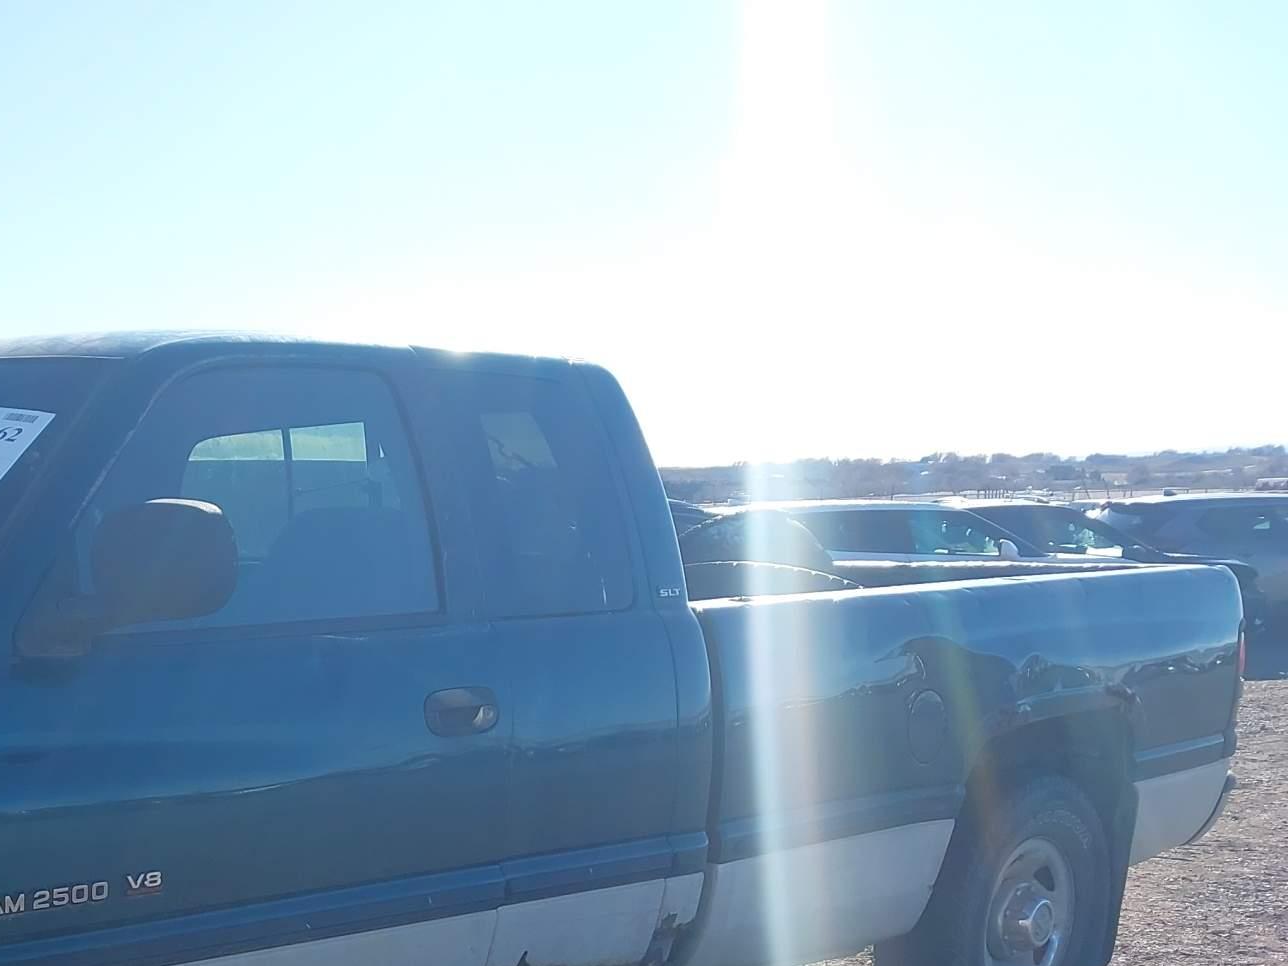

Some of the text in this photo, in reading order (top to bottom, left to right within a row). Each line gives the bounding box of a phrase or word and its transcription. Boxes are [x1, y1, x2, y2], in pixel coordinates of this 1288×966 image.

[659, 587, 681, 597] SLT
[32, 881, 109, 910] 2500
[126, 871, 162, 889] V8
